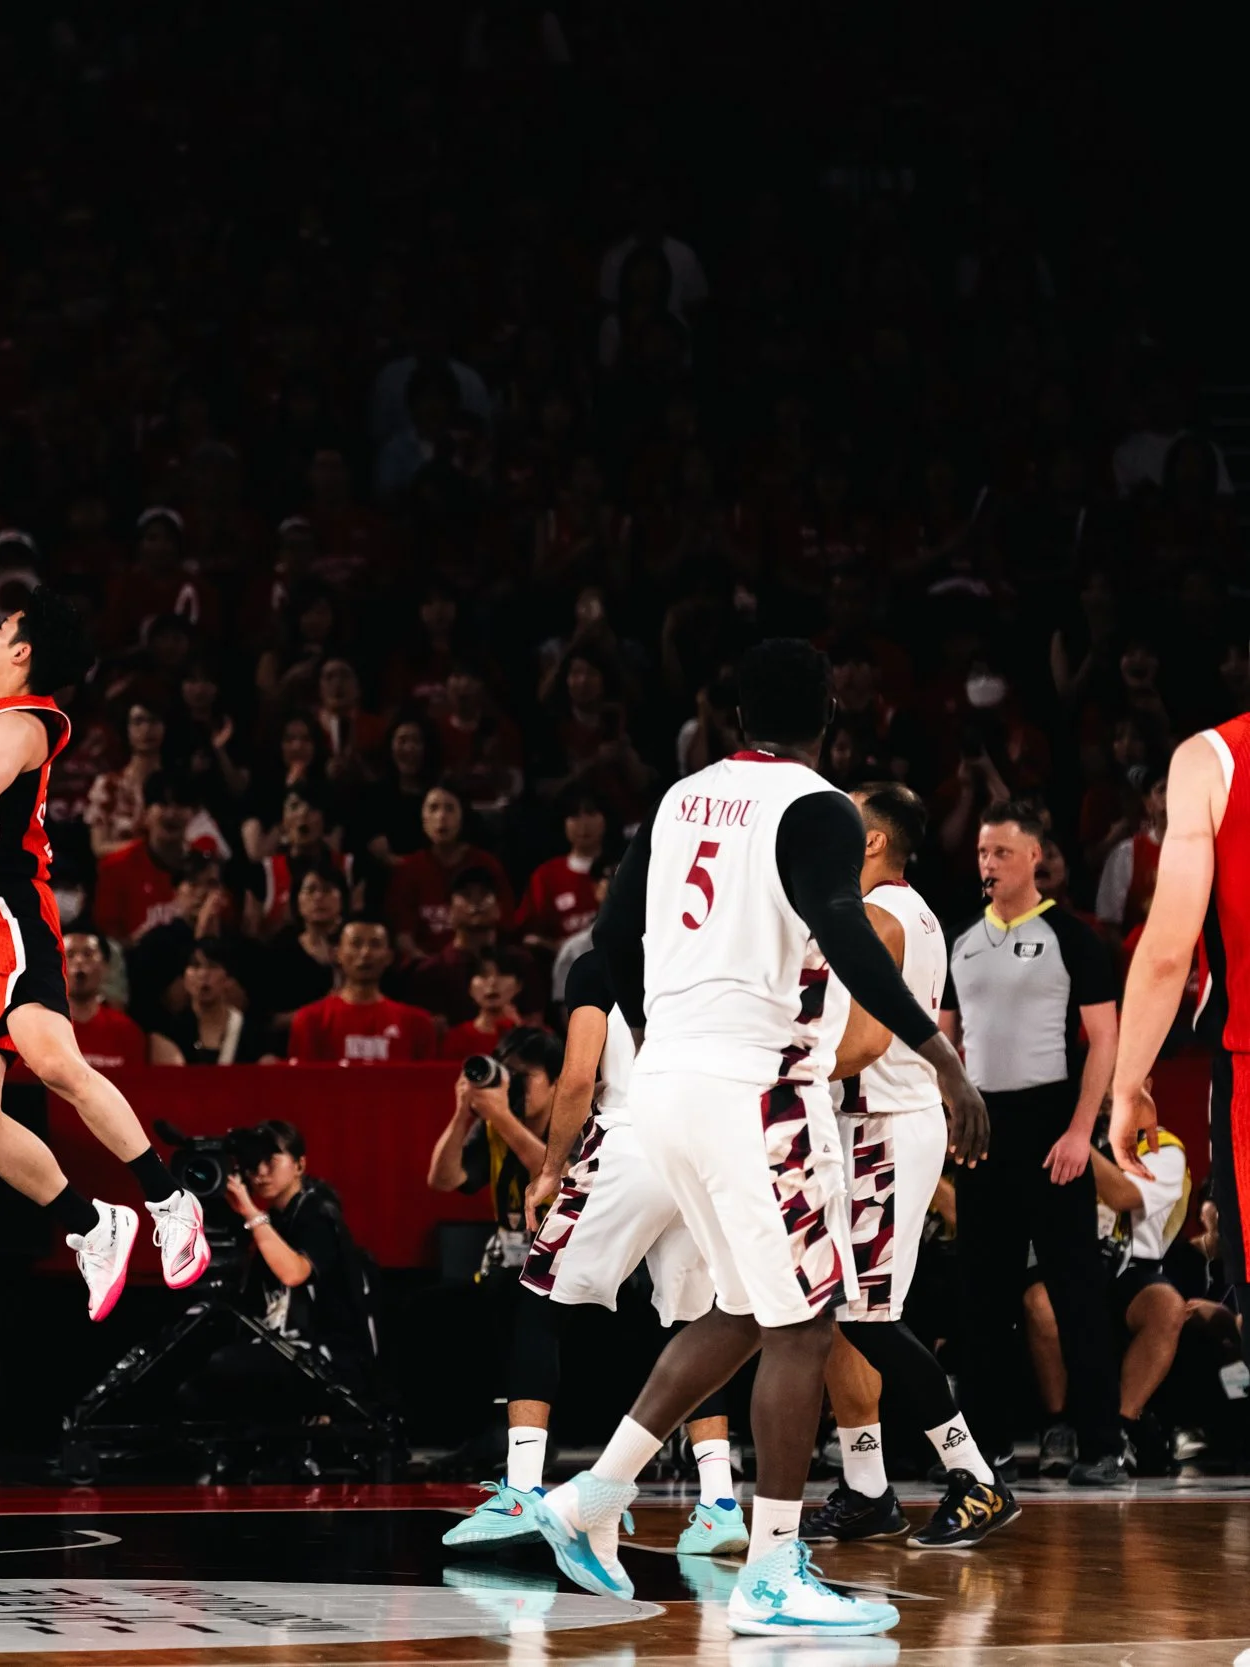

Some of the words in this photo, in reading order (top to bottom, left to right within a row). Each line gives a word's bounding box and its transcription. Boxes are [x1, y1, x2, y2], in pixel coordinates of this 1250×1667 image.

[675, 794, 760, 828] SEYTOU
[682, 840, 721, 931] 5
[851, 1442, 880, 1452] PEAK
[942, 1431, 969, 1451] PEAK
